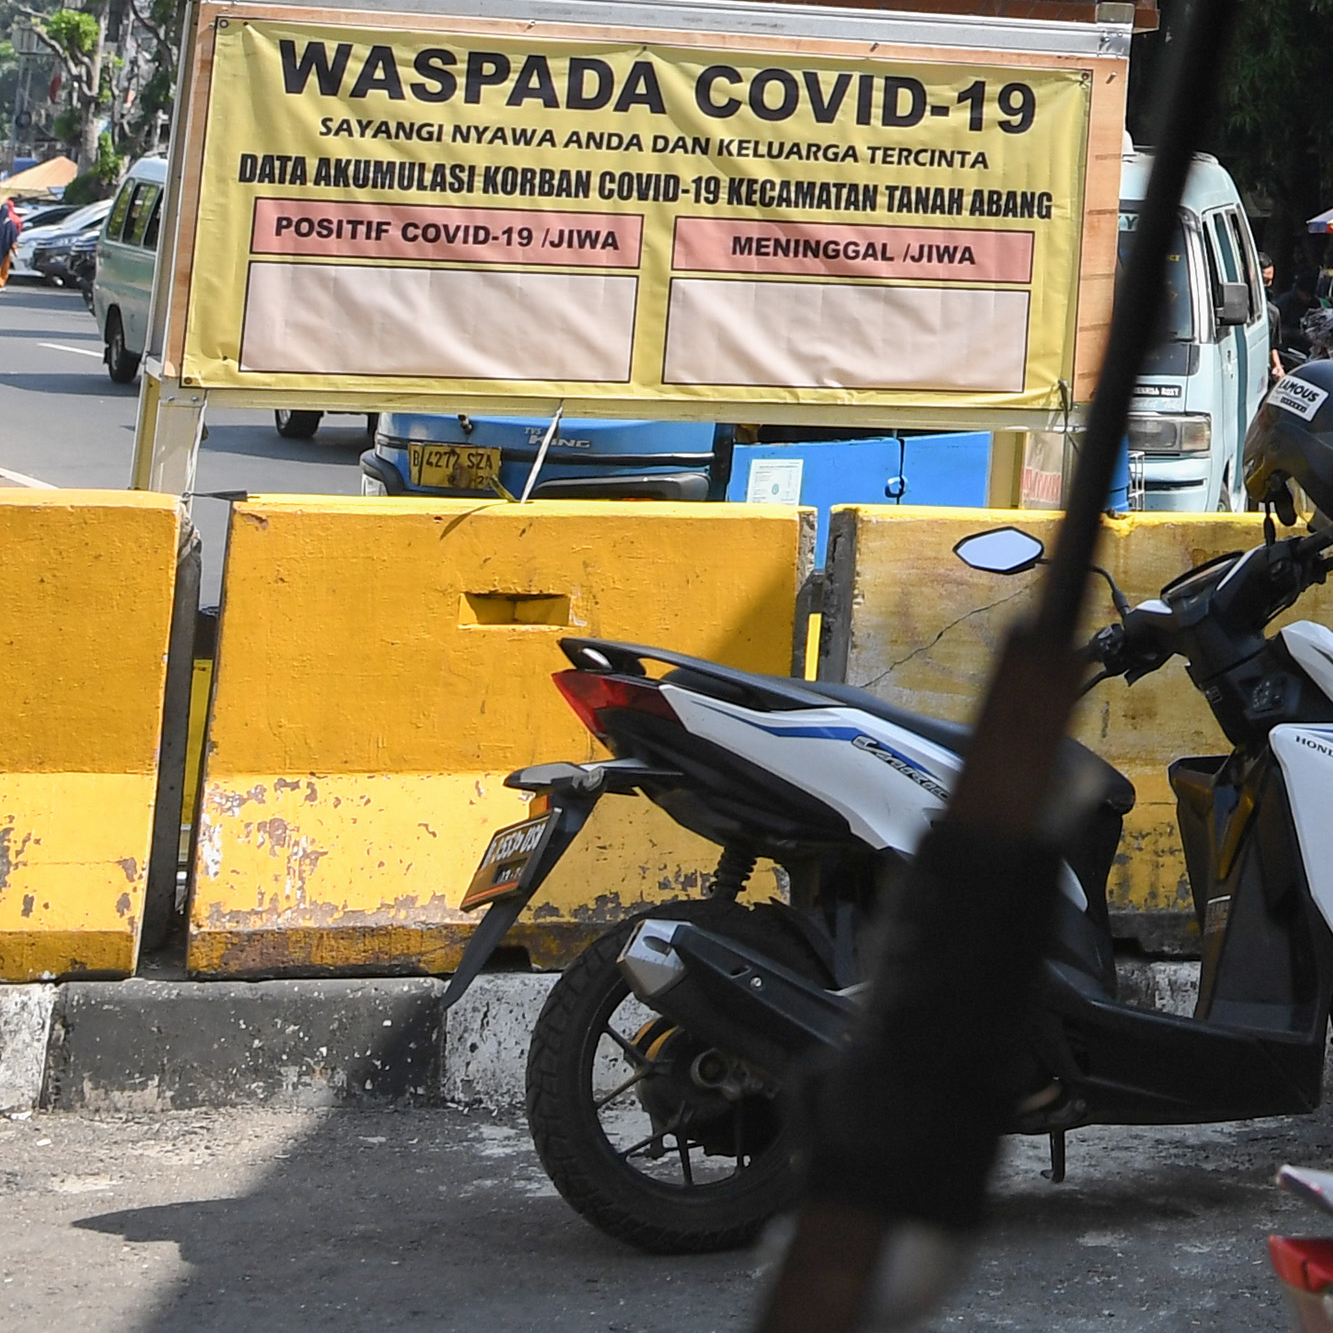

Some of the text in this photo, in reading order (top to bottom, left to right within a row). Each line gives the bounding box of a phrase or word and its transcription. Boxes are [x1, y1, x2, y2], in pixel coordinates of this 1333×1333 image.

[278, 39, 1036, 135] WASPADA COVID-19
[319, 117, 989, 170] SAYANGI NYAWA ANDA DAN KELUARGA TERCINTA
[238, 153, 1053, 220] DATA AKUMULASI KORBAN COVID-19 KECAMATAN TANAH ABANG
[275, 216, 620, 251] POSITIF COVID-19 /JIWA
[731, 235, 976, 265] MENINGGAL /JIWA
[524, 426, 543, 436] TVS
[528, 436, 591, 449] KING
[467, 452, 494, 470] SZA
